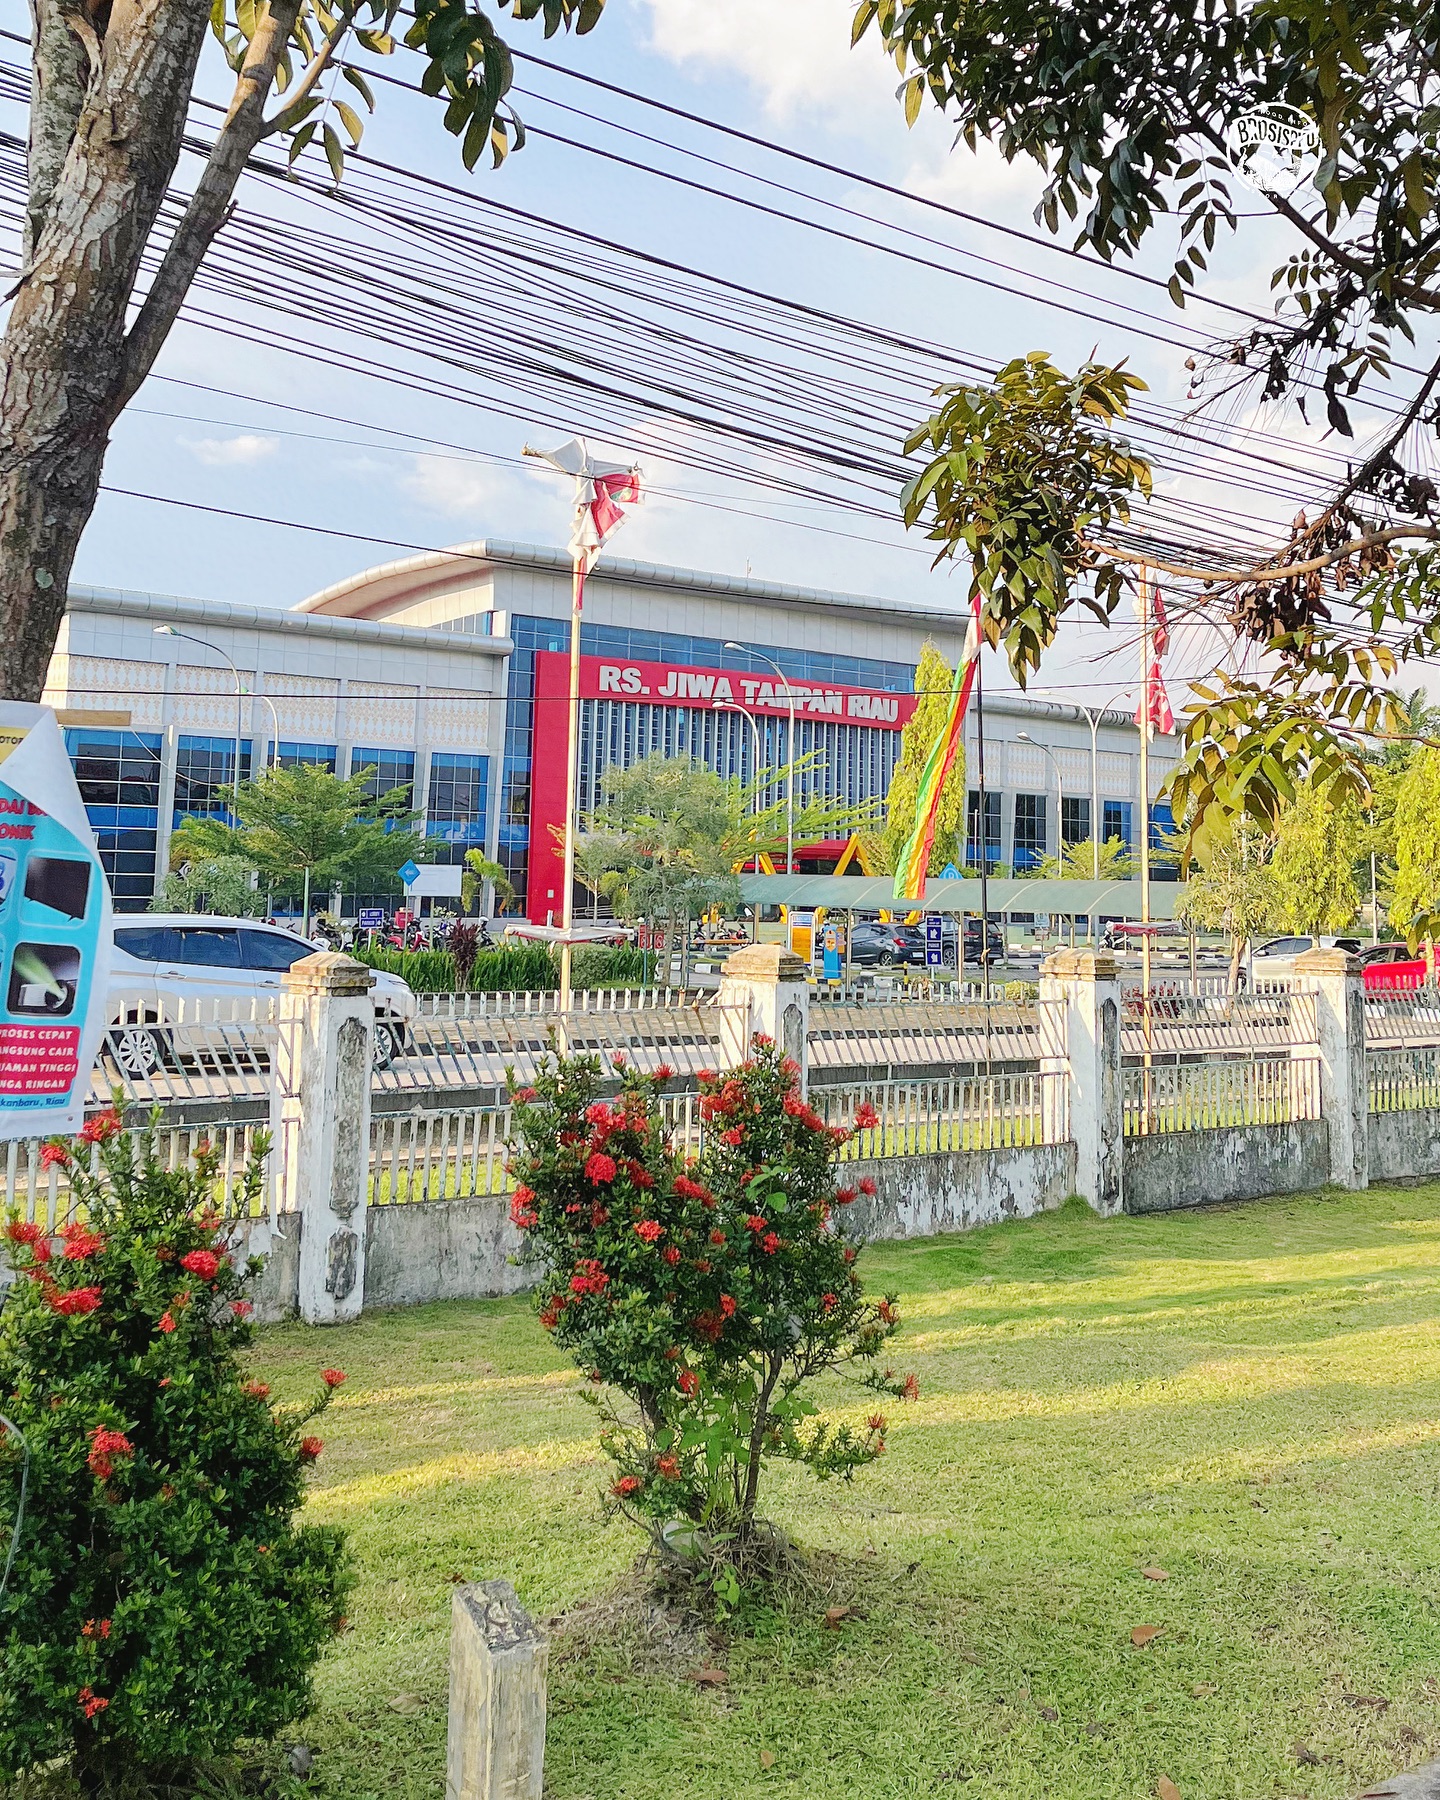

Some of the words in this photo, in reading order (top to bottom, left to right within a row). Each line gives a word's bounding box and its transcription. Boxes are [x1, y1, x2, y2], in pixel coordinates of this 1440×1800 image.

[598, 665, 651, 695] RS.
[657, 671, 735, 703] JIWA
[739, 679, 843, 715] TAMPAN
[847, 695, 899, 723] RIAU
[0, 1029, 36, 1039] ROSES
[38, 1030, 72, 1040] CEPAT
[48, 1047, 74, 1057] CAIR
[40, 1063, 76, 1073] TINGGI
[26, 1079, 66, 1089] RINGAN
[45, 1097, 65, 1105] Riau
